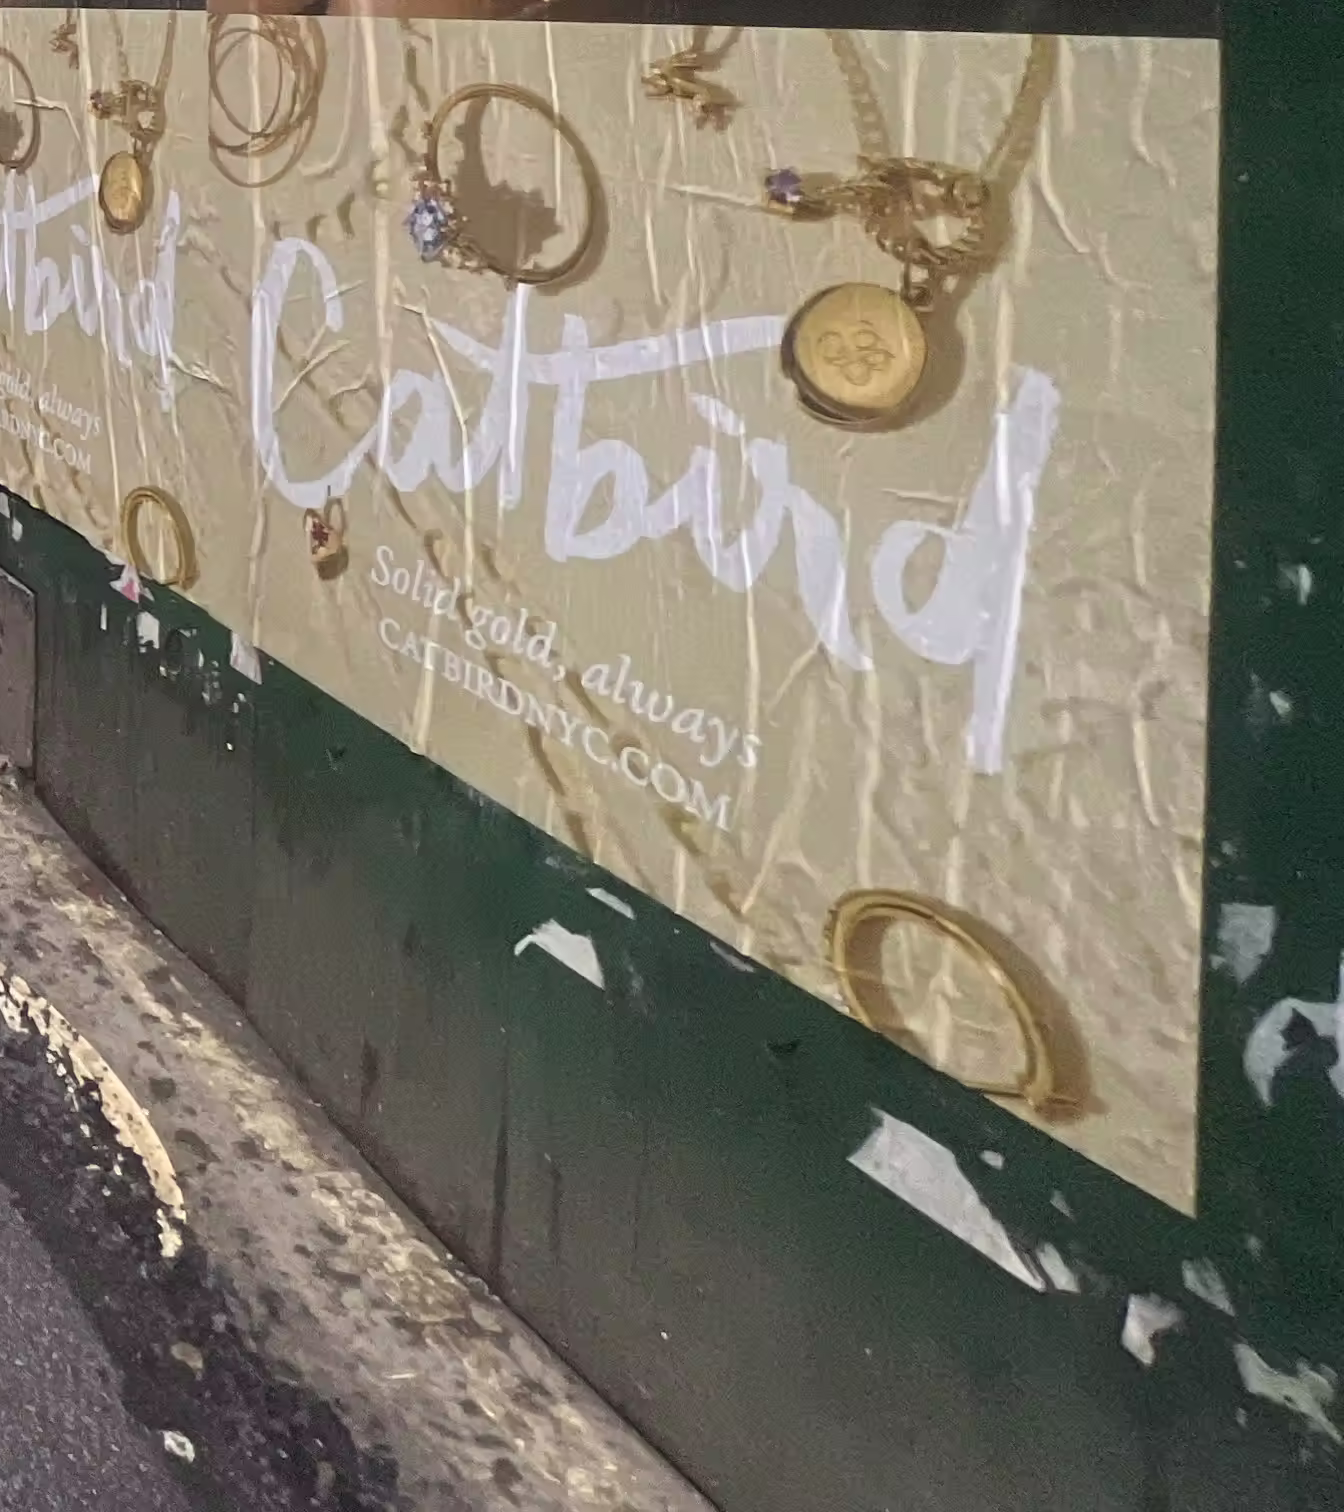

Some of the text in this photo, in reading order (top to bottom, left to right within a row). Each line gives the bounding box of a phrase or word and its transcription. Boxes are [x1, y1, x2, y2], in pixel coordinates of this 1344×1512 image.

[39, 384, 102, 441] always
[252, 238, 1063, 776] Catbird
[371, 545, 763, 769] Solid gold, always
[378, 617, 732, 832] CATBIRDNYC.COM
